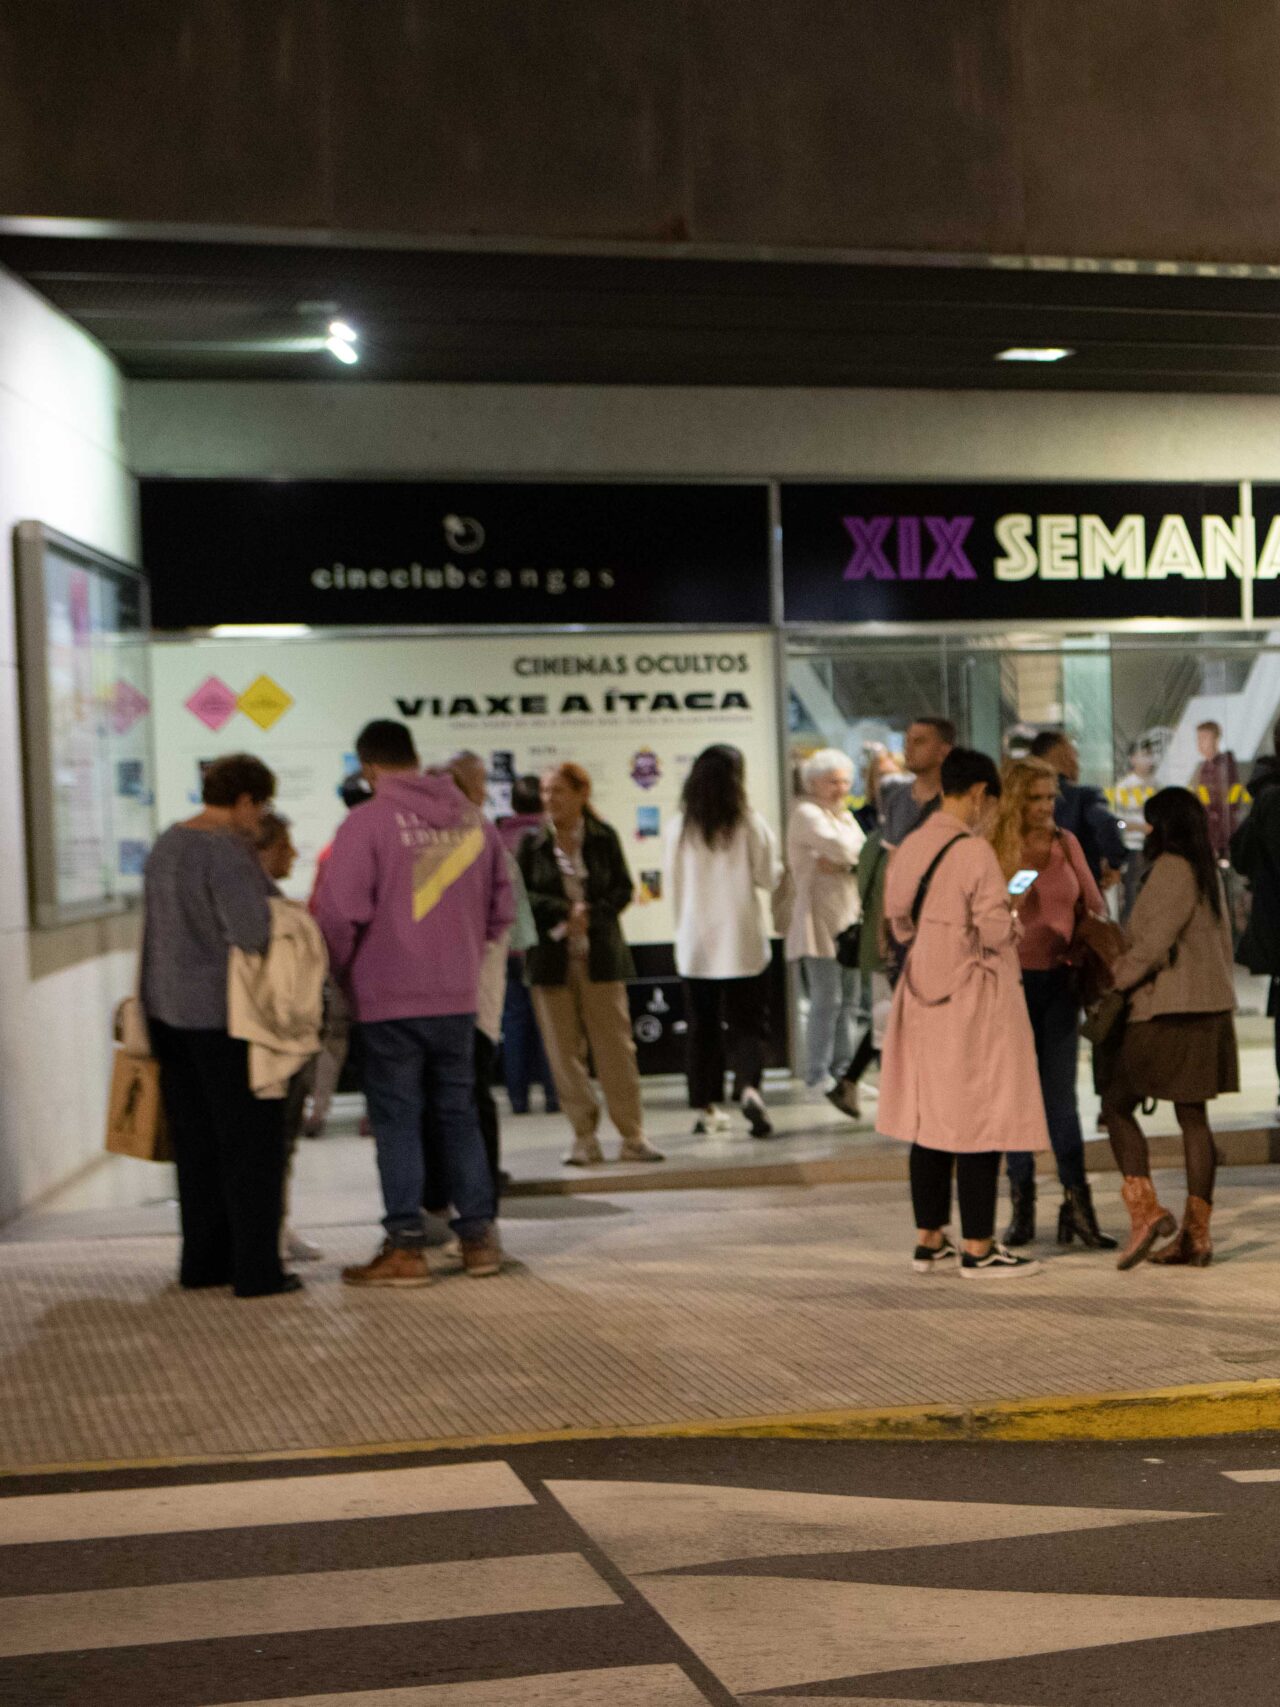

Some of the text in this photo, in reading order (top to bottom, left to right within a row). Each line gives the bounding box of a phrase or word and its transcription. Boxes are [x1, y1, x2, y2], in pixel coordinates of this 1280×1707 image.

[842, 515, 978, 580] XIX
[514, 652, 750, 678] CINEMAS OCULTOS
[396, 687, 752, 718] VIAXE A ÍTACA
